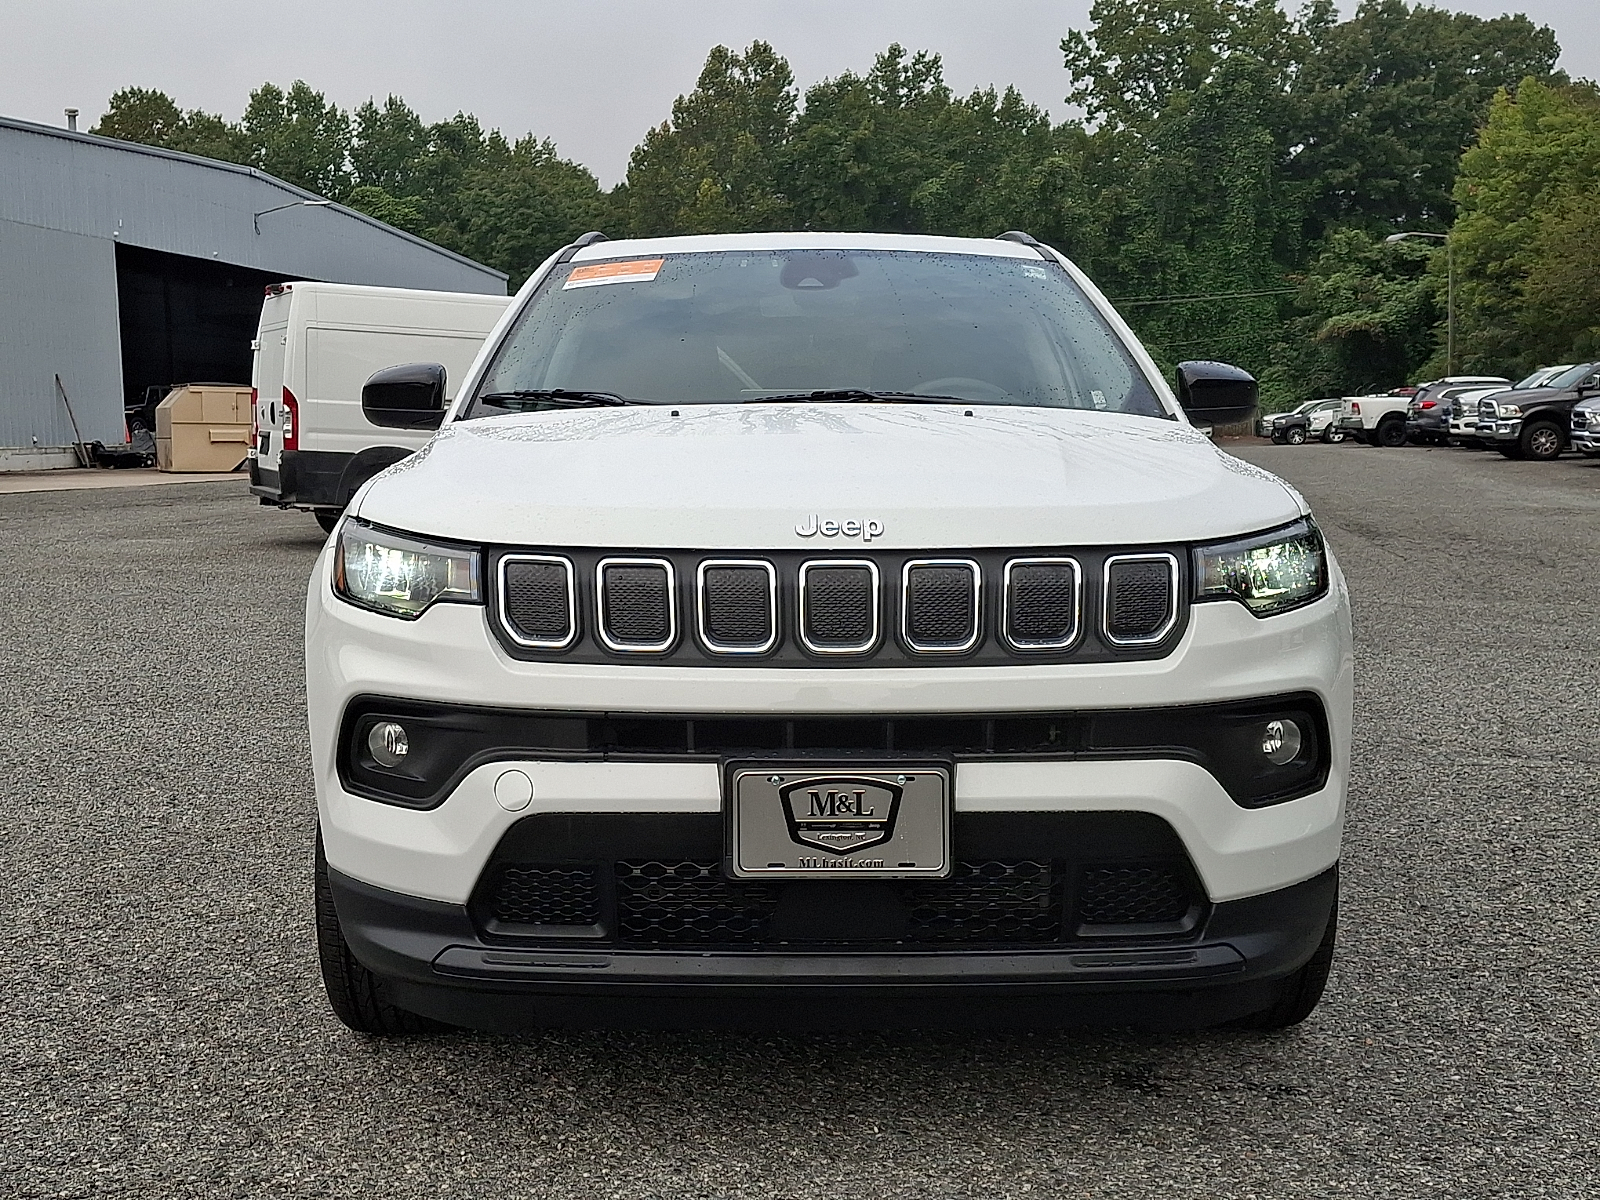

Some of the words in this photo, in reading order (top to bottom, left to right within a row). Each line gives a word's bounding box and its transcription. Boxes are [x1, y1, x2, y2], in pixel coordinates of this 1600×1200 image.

[794, 513, 885, 542] Jeep
[807, 789, 875, 817] M&L
[798, 856, 884, 868] MLhasit.com
